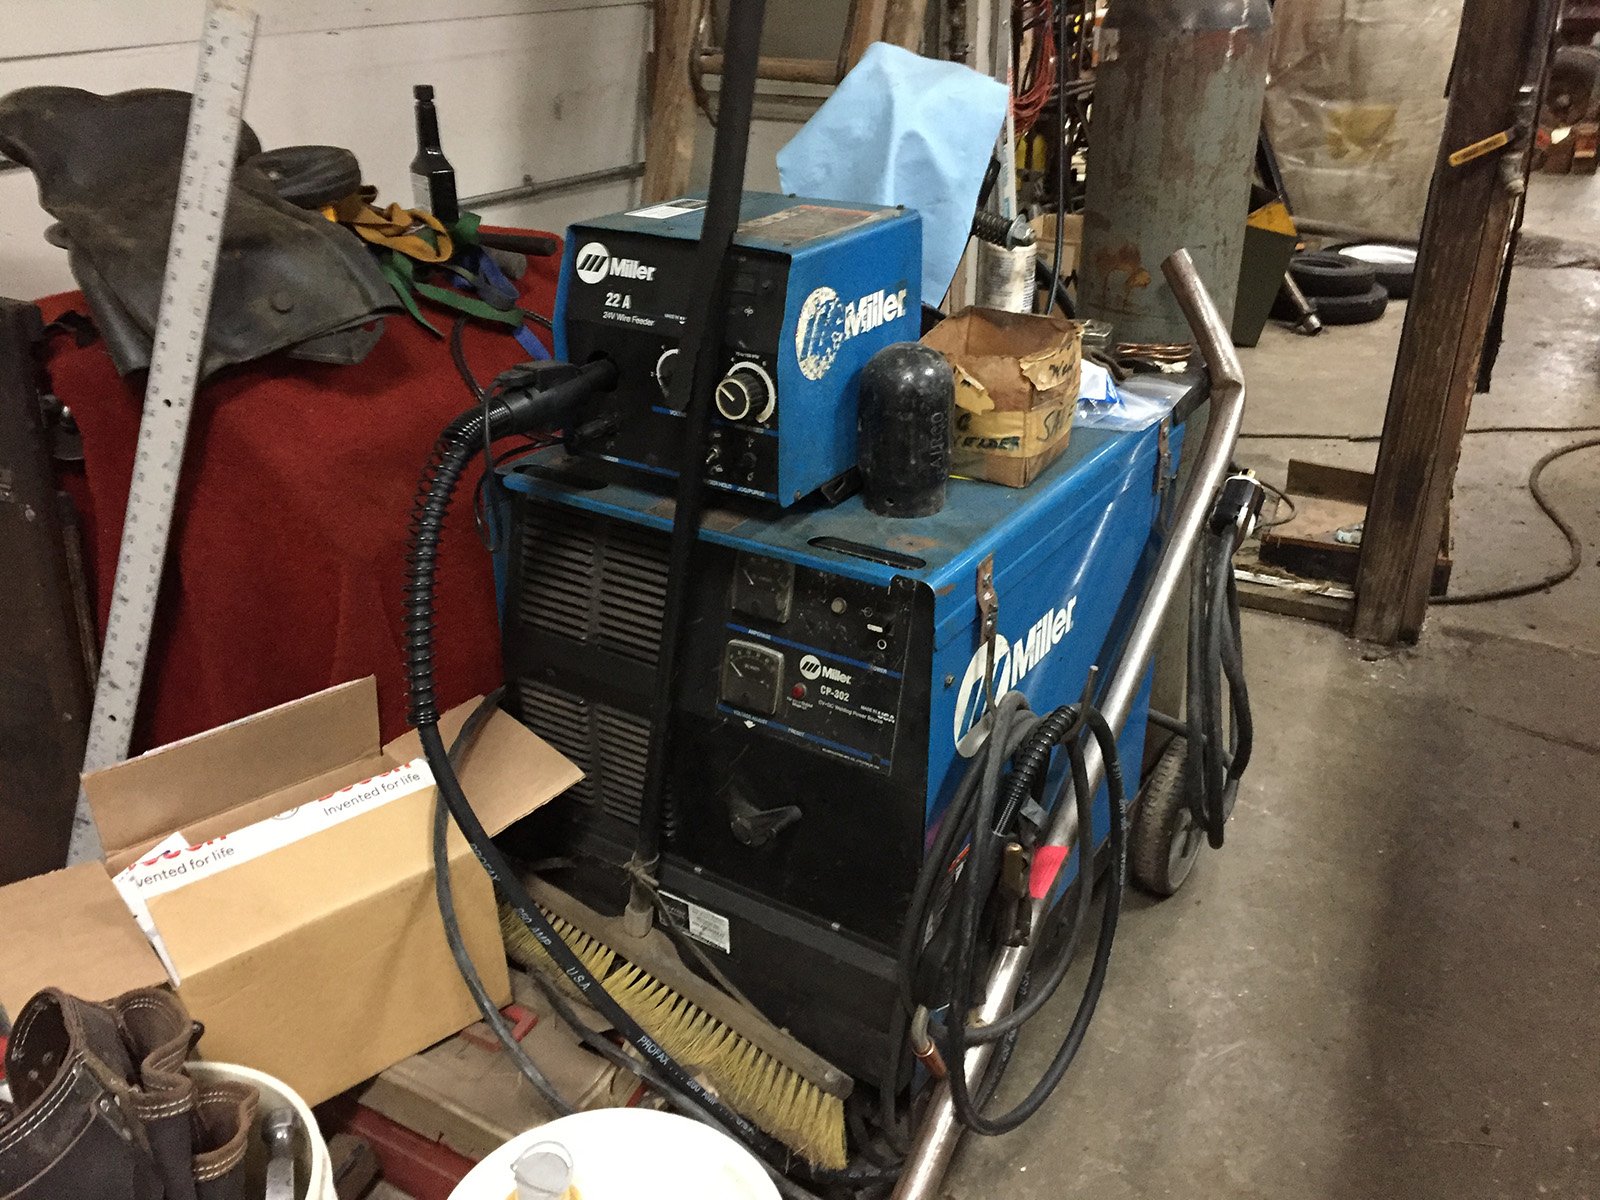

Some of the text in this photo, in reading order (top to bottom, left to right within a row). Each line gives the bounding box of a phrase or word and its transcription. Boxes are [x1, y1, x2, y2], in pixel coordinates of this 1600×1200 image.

[609, 257, 657, 281] Miller
[604, 291, 632, 309] 22 A
[602, 311, 615, 320] 24V
[616, 313, 631, 323] Wire
[631, 315, 656, 327] Feeder
[844, 288, 907, 340] Miller
[1011, 596, 1077, 689] Miller
[821, 665, 852, 686] Miller
[820, 684, 850, 702] CP-302
[834, 703, 853, 717] Welding
[852, 709, 868, 720] Power
[867, 713, 884, 725] Source
[323, 786, 380, 817] Invented
[381, 780, 400, 795] for
[400, 771, 421, 789] life
[189, 856, 210, 871] for
[211, 847, 235, 861] life
[636, 1035, 670, 1066] PROFAX
